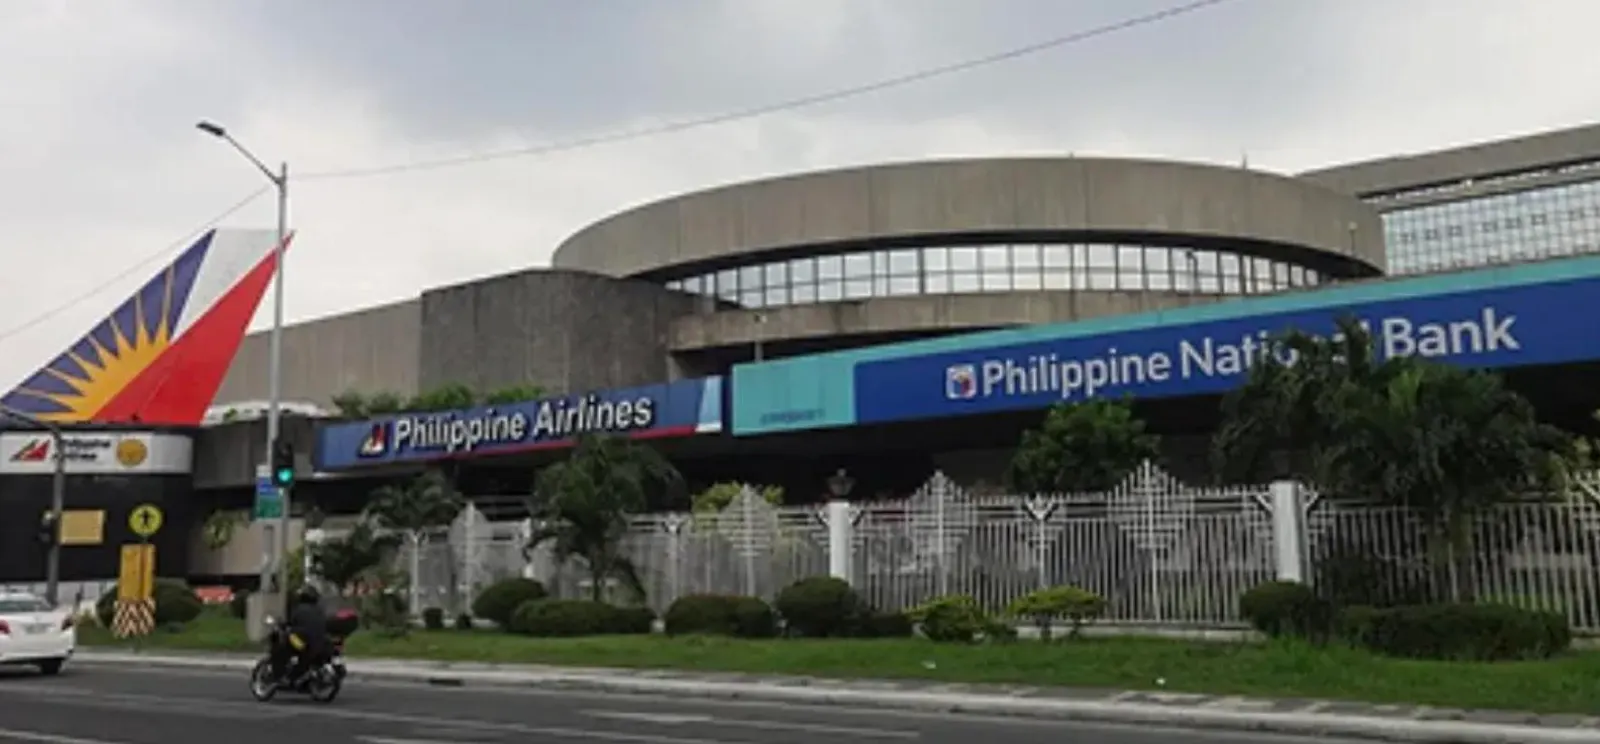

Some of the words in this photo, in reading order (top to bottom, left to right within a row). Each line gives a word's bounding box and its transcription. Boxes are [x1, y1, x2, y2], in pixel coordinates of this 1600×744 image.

[983, 348, 1172, 399] Philippine
[1180, 319, 1371, 379] Natio
[1382, 306, 1520, 359] Bank
[394, 408, 524, 453] Philippine
[532, 393, 652, 437] Airlines
